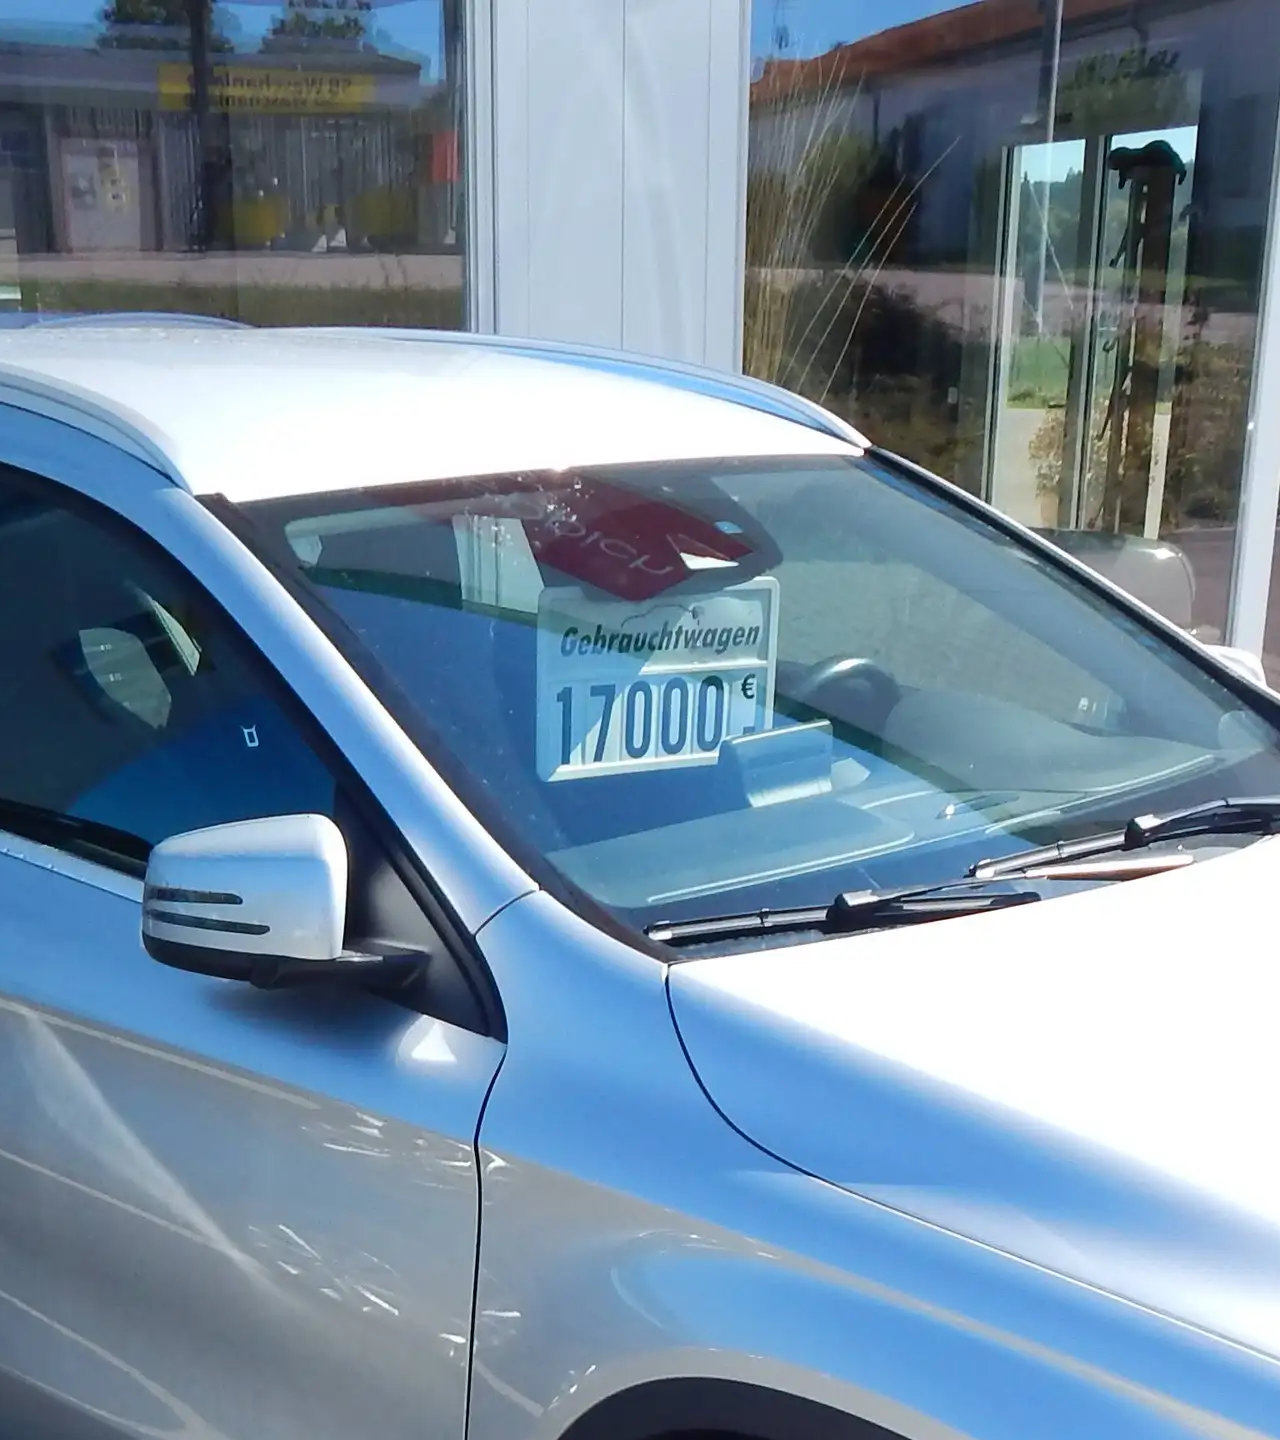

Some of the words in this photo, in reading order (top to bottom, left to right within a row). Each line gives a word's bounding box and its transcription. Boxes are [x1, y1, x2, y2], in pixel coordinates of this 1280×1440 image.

[560, 624, 760, 656] Gebrauchtwagen
[556, 675, 724, 765] 17000
[740, 673, 756, 699] €
